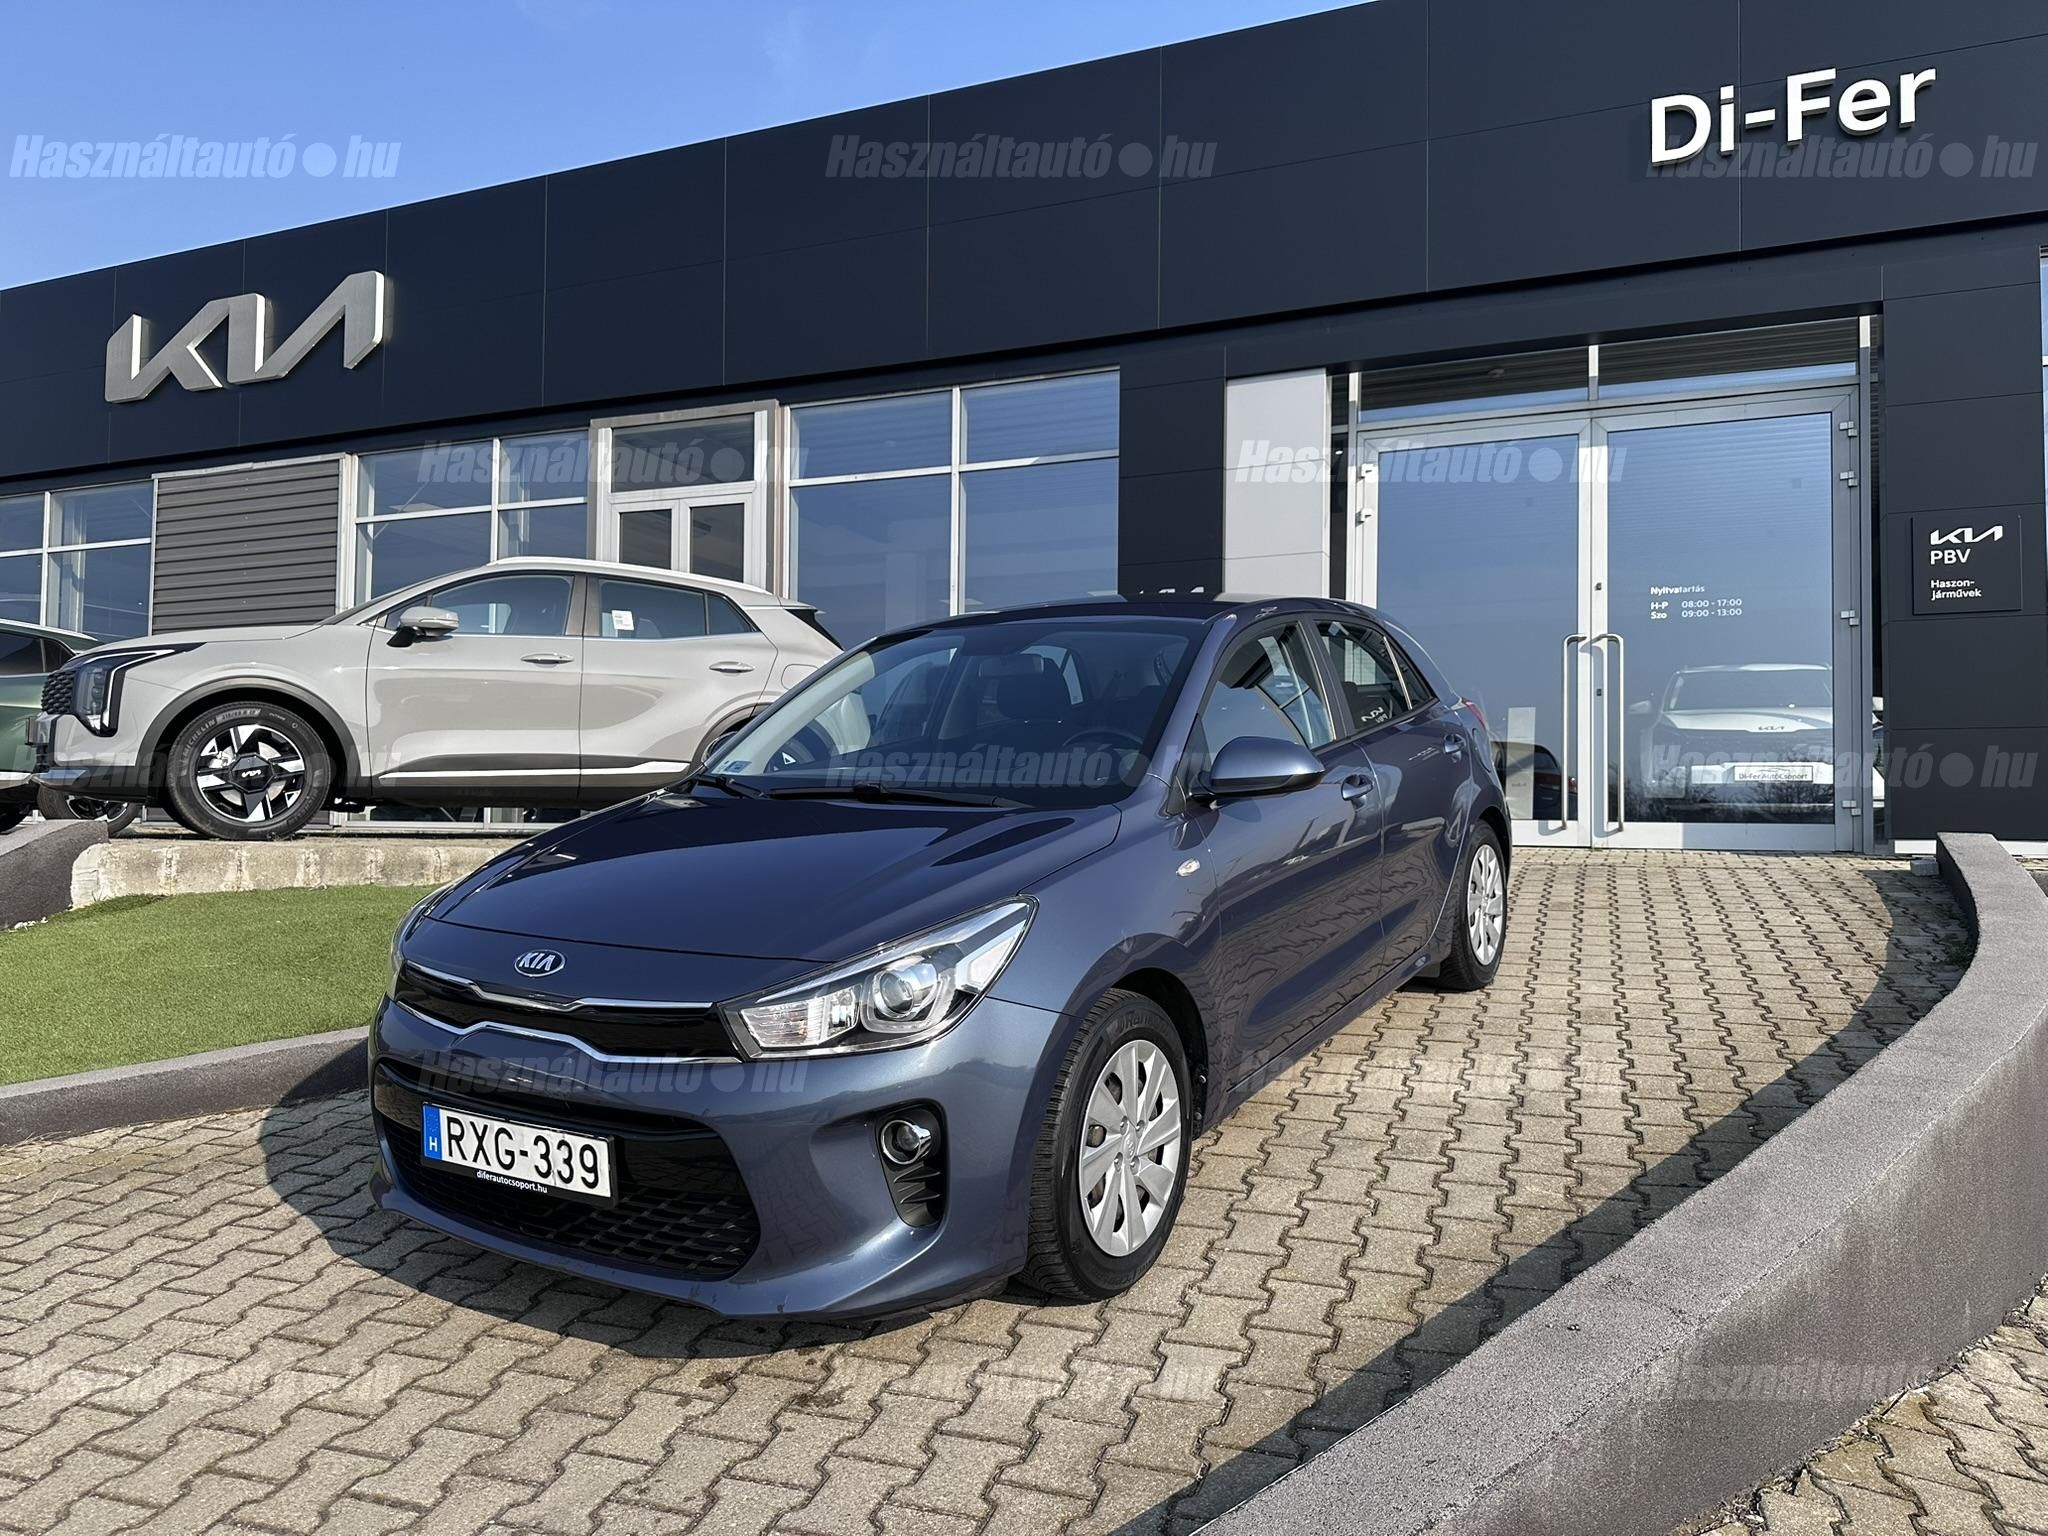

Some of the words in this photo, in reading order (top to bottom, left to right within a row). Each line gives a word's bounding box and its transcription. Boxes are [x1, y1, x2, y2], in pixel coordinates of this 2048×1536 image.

[1651, 68, 1937, 166] Di-Fer
[105, 270, 385, 403] KIA
[1930, 525, 2003, 545] KIA
[1930, 548, 1971, 565] PBV
[1930, 579, 1975, 589] Haszon-
[1650, 601, 1669, 610] H-P
[1681, 600, 1709, 608] 08:00
[1717, 598, 1742, 607] 17:00
[1650, 611, 1668, 620] Szo
[1681, 609, 1709, 618] 09:00
[1717, 608, 1742, 617] 13:00
[518, 952, 556, 971] KIA
[429, 1136, 438, 1152] H
[446, 1115, 599, 1189] RXG-339
[476, 1170, 548, 1194] diferautocsoport.hu
